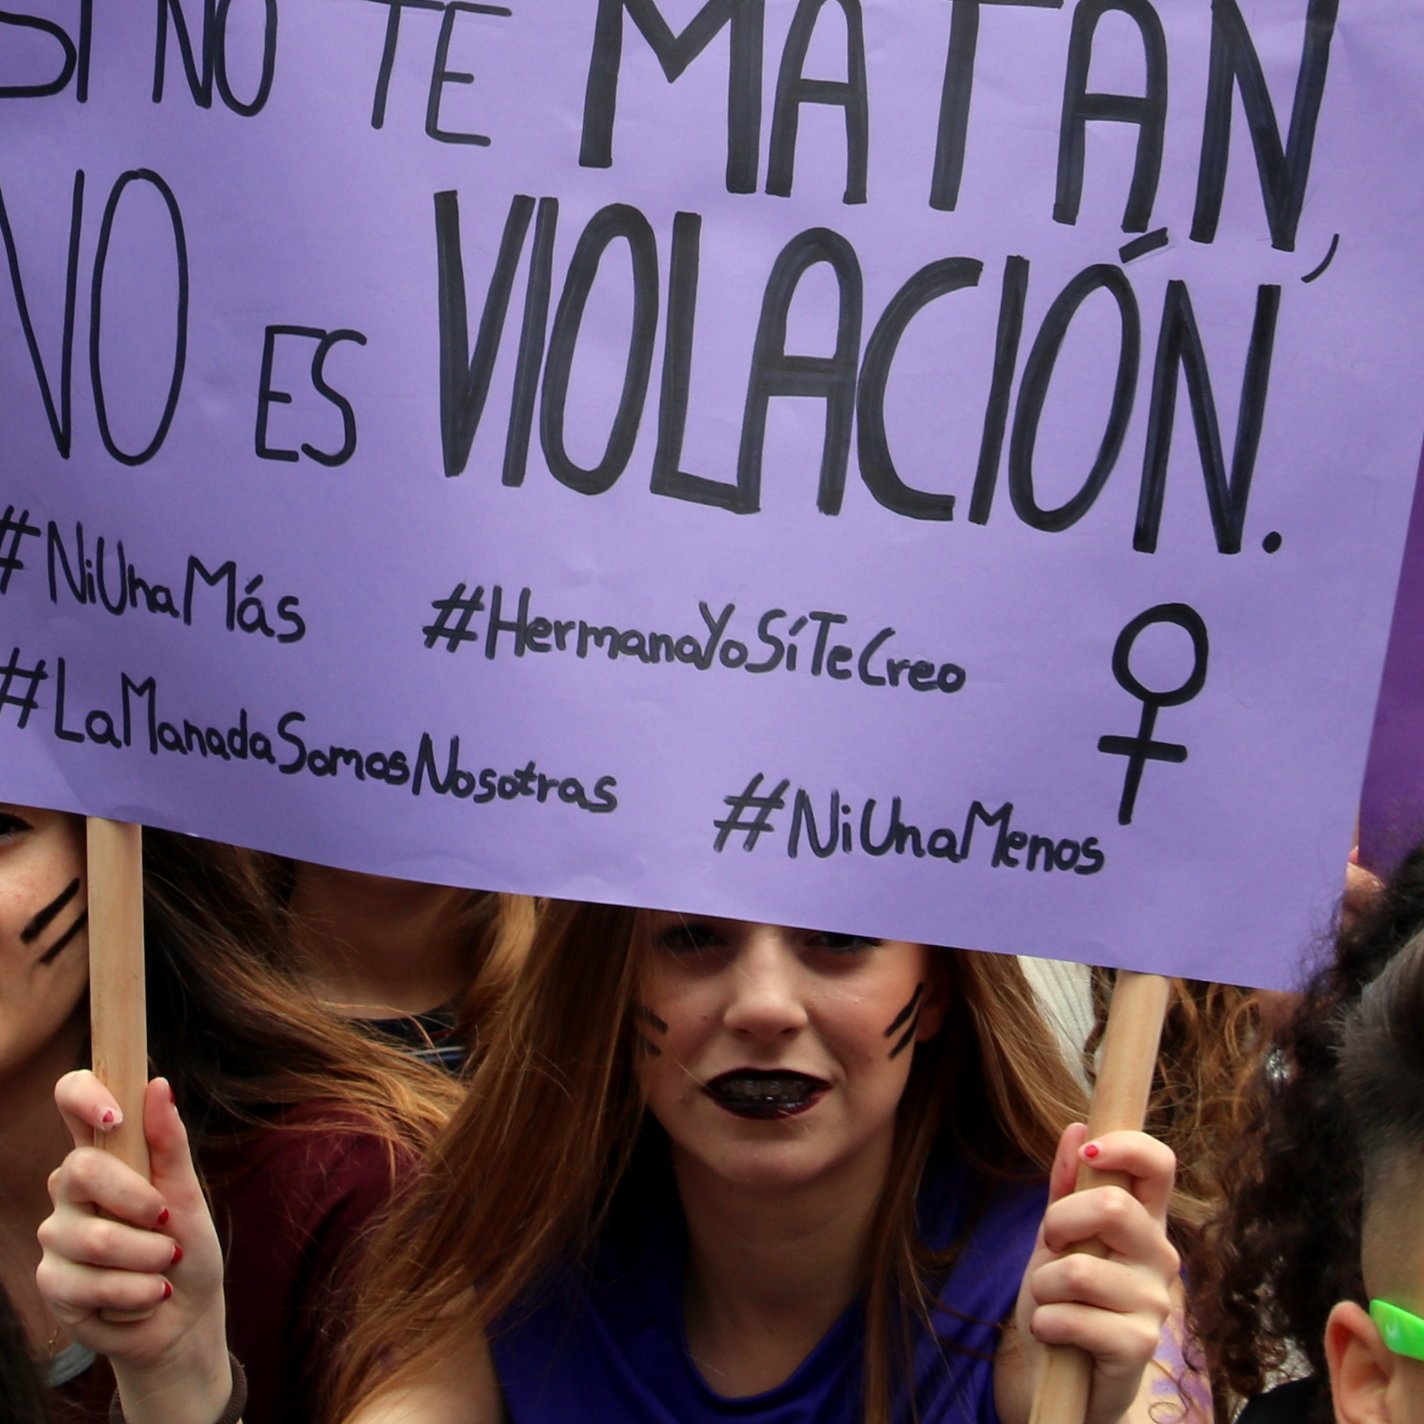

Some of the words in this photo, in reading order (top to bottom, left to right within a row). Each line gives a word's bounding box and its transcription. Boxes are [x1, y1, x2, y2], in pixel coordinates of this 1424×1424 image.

[255, 324, 368, 468] ES
[433, 188, 1284, 554] VIOLACIÓN.
[712, 770, 1108, 877] #NiUnaMenos
